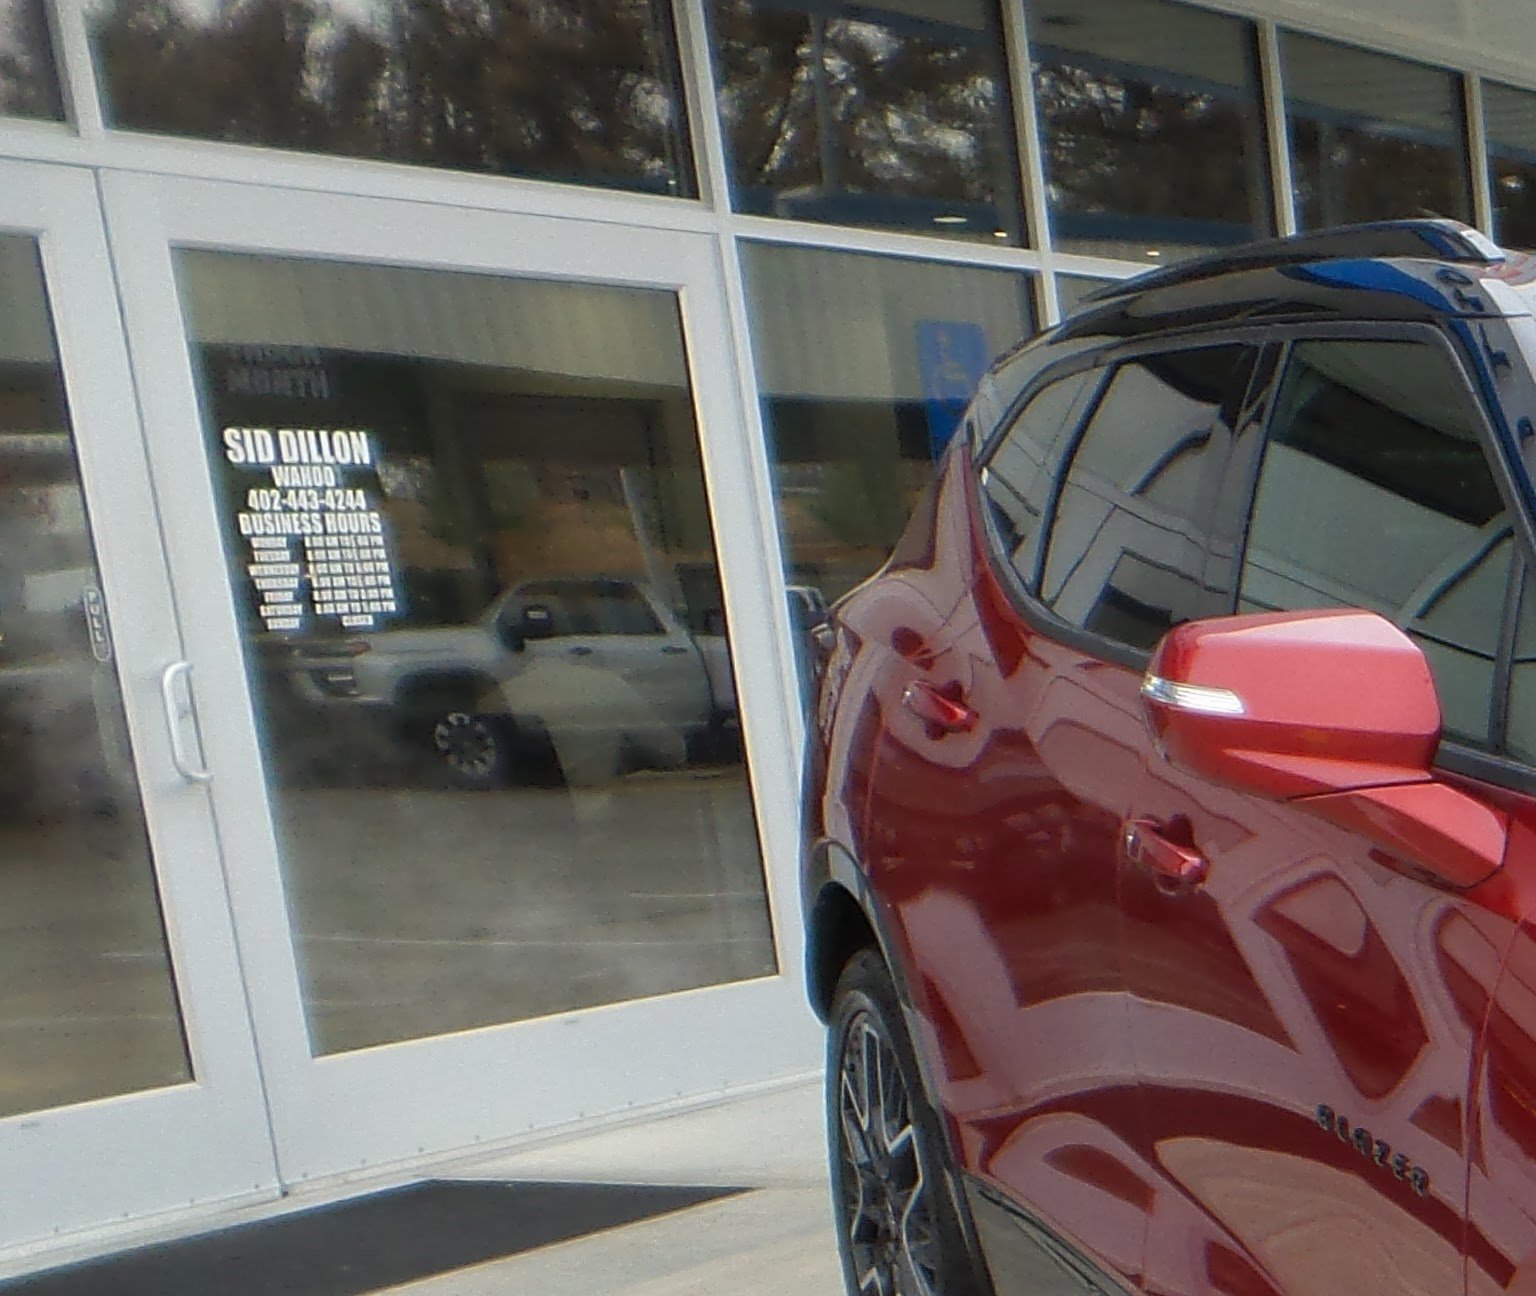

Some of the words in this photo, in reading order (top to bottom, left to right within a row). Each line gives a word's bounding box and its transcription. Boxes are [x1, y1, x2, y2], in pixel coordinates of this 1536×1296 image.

[223, 427, 275, 464] SID
[278, 429, 371, 465] DILLON
[271, 465, 335, 488] WAHOO
[247, 489, 367, 511] 402-443-4244
[238, 512, 323, 535] BUSINESS
[324, 512, 383, 535] HOURS
[1316, 1103, 1430, 1198] BLAZER
